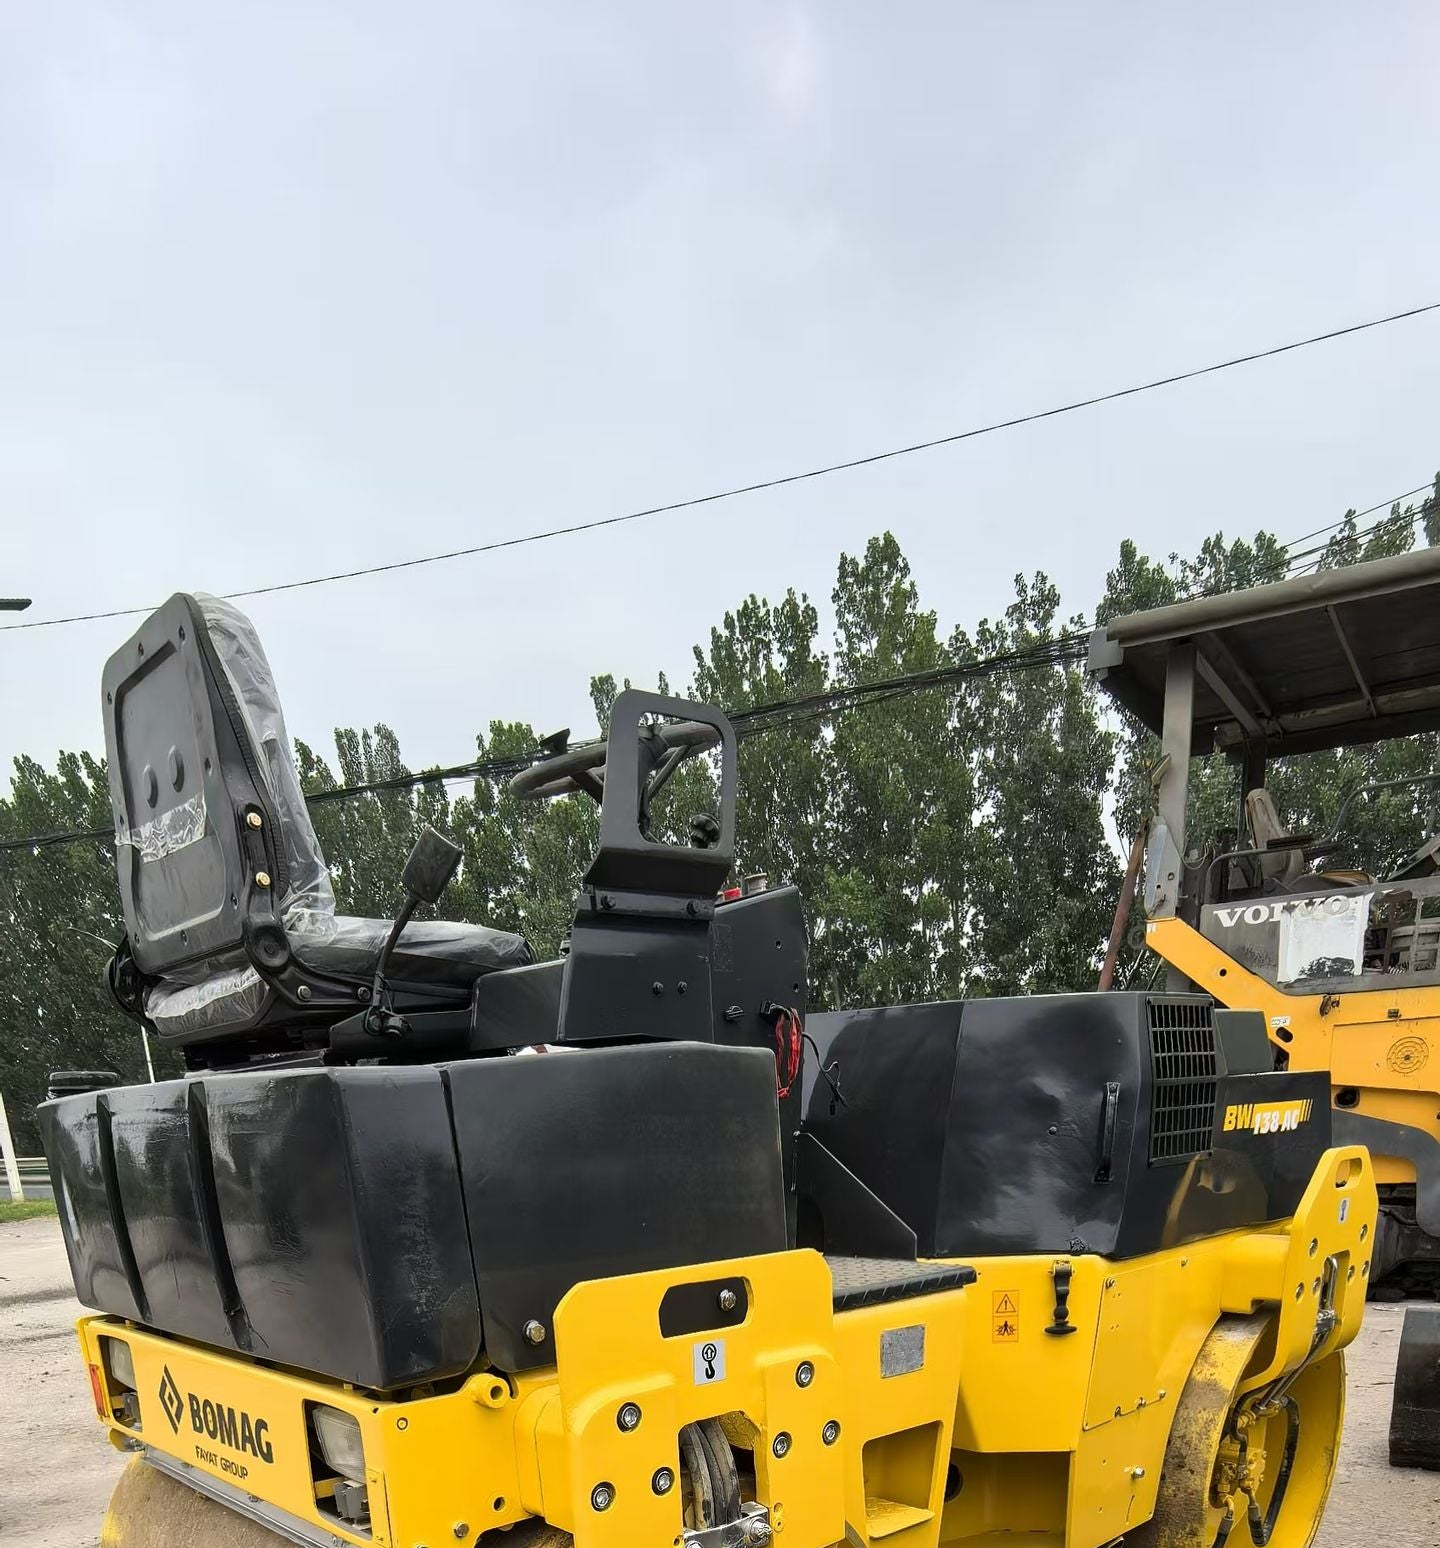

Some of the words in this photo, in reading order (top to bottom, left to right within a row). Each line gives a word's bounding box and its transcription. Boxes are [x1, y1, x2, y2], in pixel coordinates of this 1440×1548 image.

[1223, 1104, 1253, 1131] BW
[1253, 1112, 1280, 1135] 138
[1281, 1109, 1300, 1132] AC
[188, 1393, 274, 1464] BOMAG
[195, 1446, 218, 1467] FAYAT
[220, 1458, 248, 1480] GROUP
